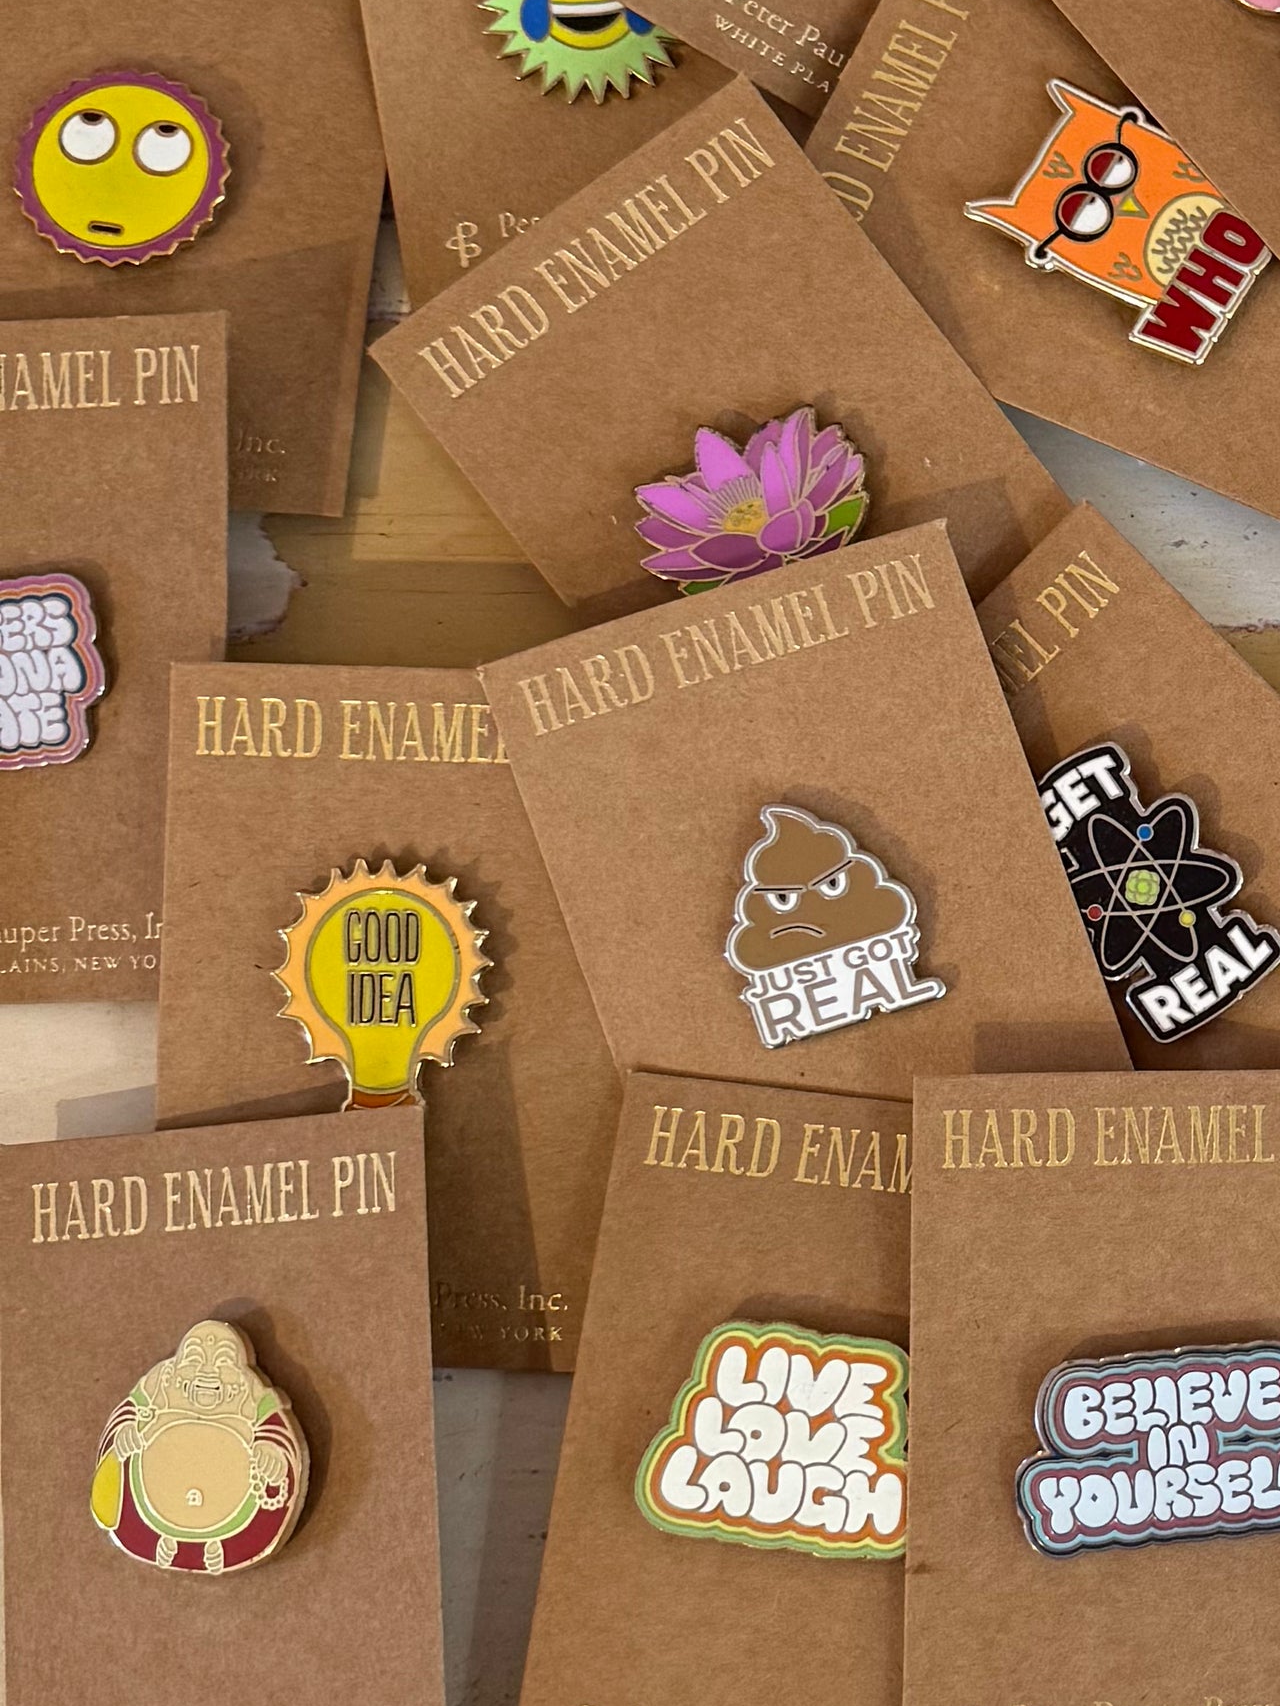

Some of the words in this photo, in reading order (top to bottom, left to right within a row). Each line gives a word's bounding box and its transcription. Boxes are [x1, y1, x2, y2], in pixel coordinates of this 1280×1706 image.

[417, 284, 550, 400] HARD
[535, 174, 708, 314] ENAMEL
[685, 118, 777, 204] PIN
[1140, 210, 1265, 356] WHO
[518, 643, 657, 736] HARD
[659, 583, 850, 689] ENAMEL
[846, 553, 937, 630] PIN
[1044, 755, 1124, 842] GET
[345, 910, 422, 971] GOOD
[751, 953, 837, 999] JUST
[843, 931, 915, 969] GOT
[1138, 926, 1274, 1035] REAL
[346, 973, 418, 1029] IDEA
[755, 955, 937, 1041] REAL
[942, 1106, 1076, 1171] HARD
[1094, 1103, 1276, 1167] ENAMEL
[31, 1173, 149, 1245] HARD
[164, 1159, 320, 1234] ENAMEL
[332, 1151, 398, 1218] PIN
[714, 1344, 897, 1421] LIVE
[692, 1401, 888, 1477] LOVE
[1145, 1423, 1211, 1472] IN
[659, 1443, 906, 1537] LAUGH
